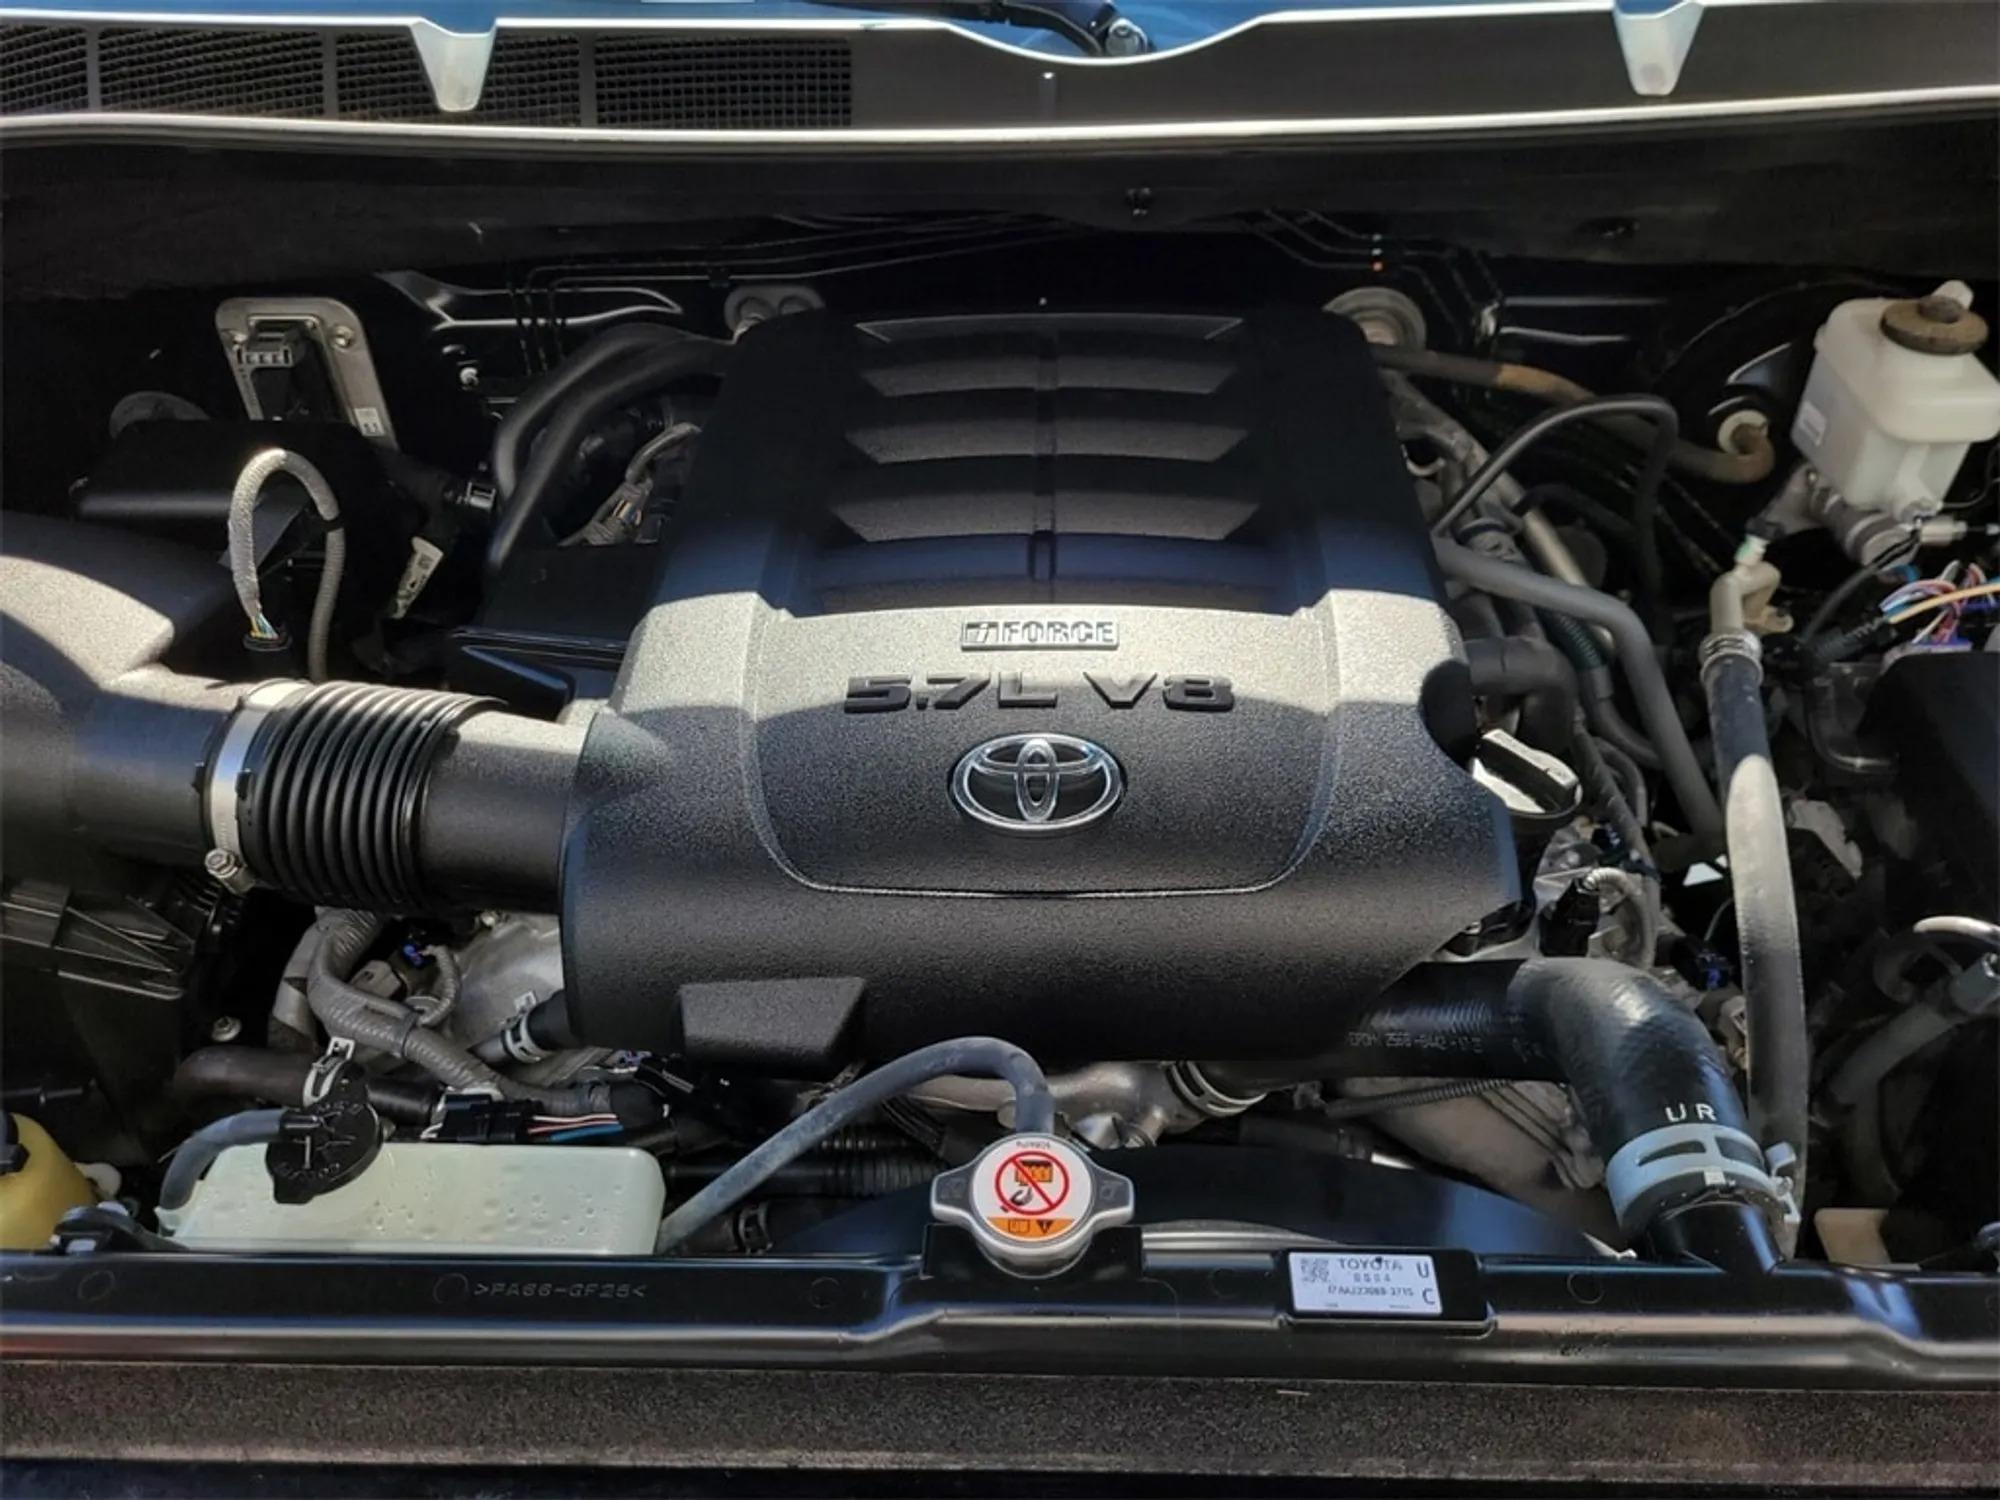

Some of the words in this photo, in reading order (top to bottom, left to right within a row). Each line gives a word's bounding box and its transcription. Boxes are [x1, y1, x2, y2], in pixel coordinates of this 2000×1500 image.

[844, 672, 1059, 713] 5.7L
[1083, 671, 1236, 713] V8
[1337, 1257, 1404, 1272] TOYOTA
[1416, 1262, 1430, 1279] U
[1421, 1287, 1436, 1306] C
